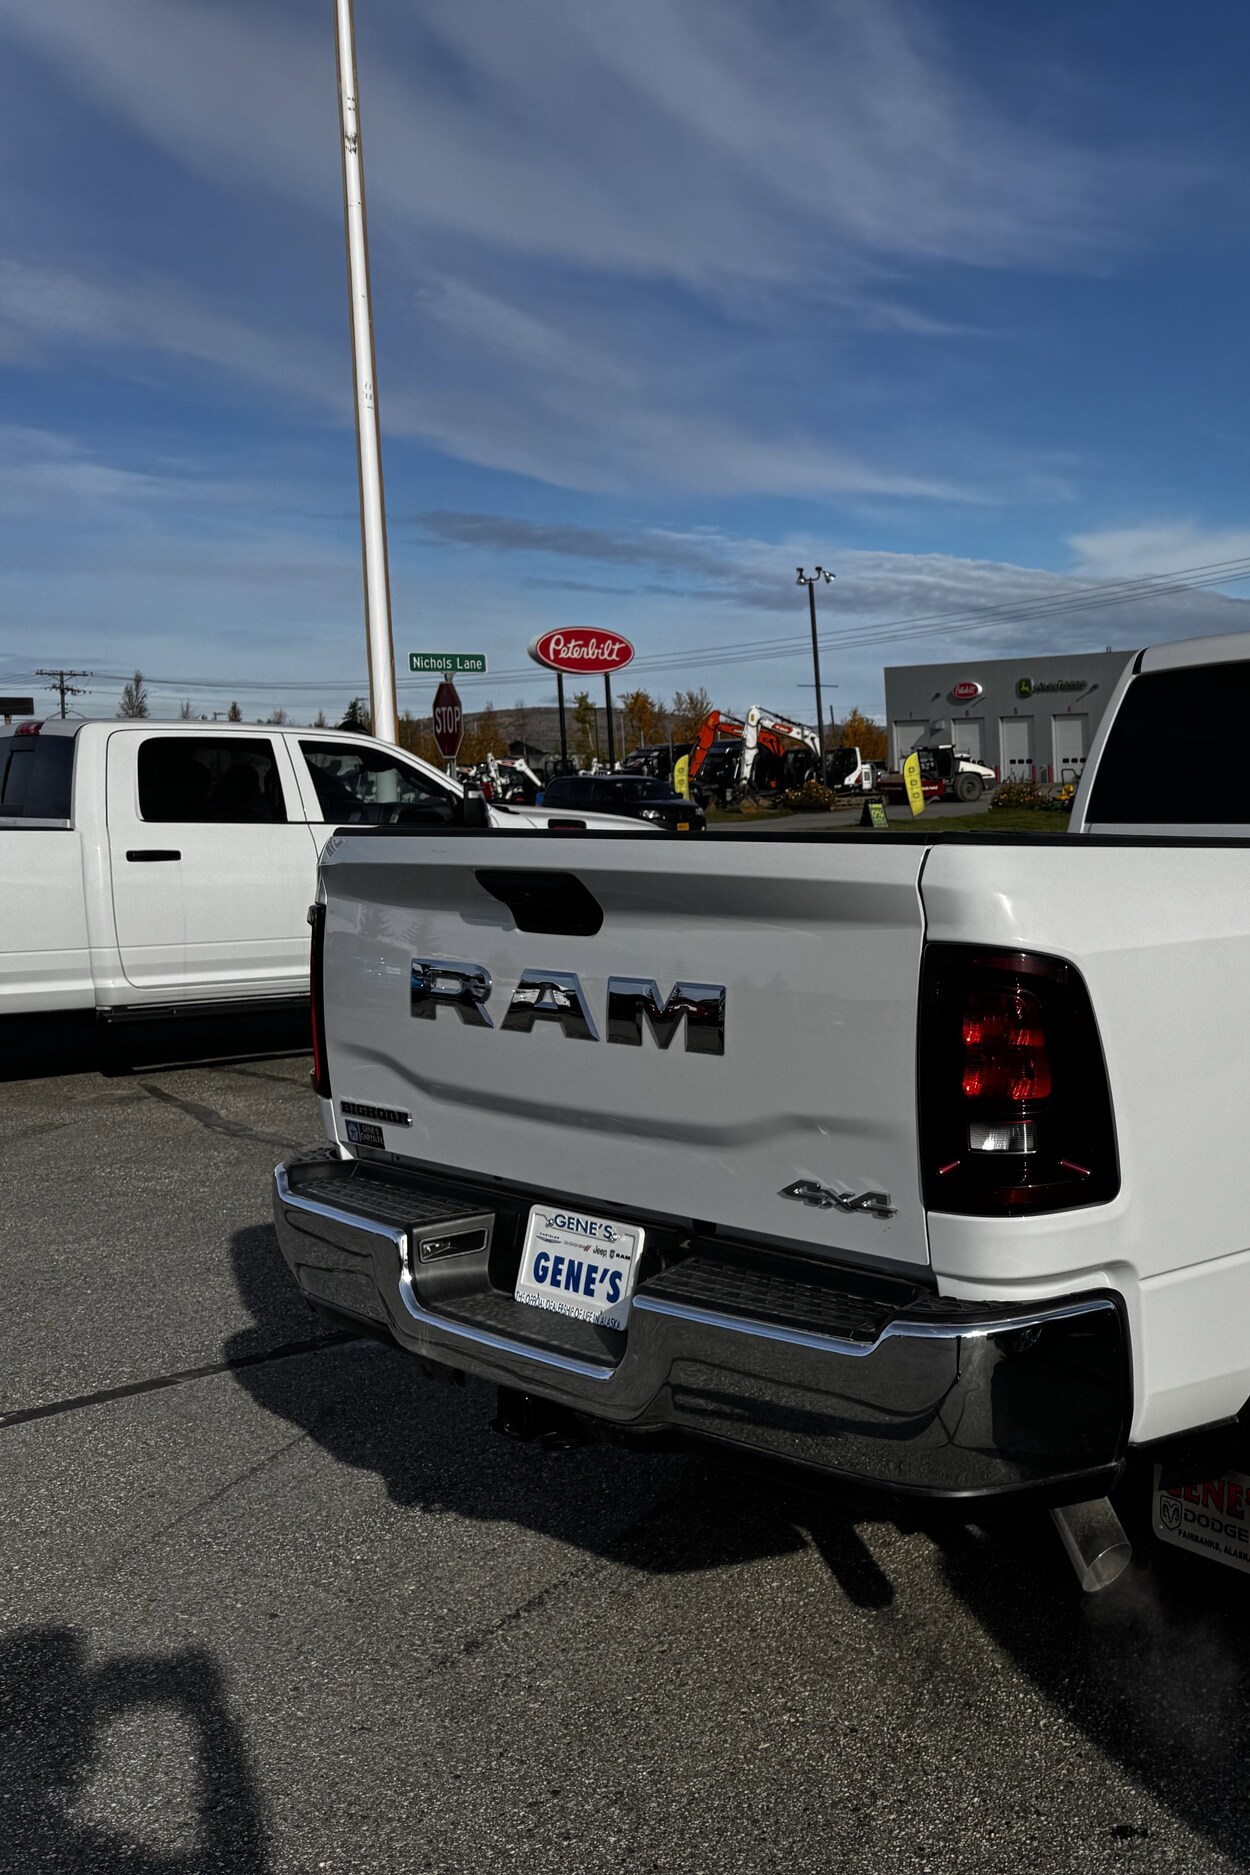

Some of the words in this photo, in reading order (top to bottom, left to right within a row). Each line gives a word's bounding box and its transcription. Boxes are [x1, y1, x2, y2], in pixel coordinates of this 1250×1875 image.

[549, 634, 626, 661] Peterbilt
[413, 656, 452, 670] Nichols
[456, 657, 483, 670] Lane
[434, 705, 461, 735] STOP
[410, 957, 727, 1056] RAM
[341, 1101, 410, 1125] BIGHORN
[554, 1213, 613, 1240] GENE'S
[593, 1245, 608, 1259] Jeep
[616, 1253, 631, 1261] RAM
[533, 1251, 623, 1304] GENE'S
[1184, 1508, 1250, 1544] DODGE
[1178, 1528, 1222, 1554] FAIRBANKS,
